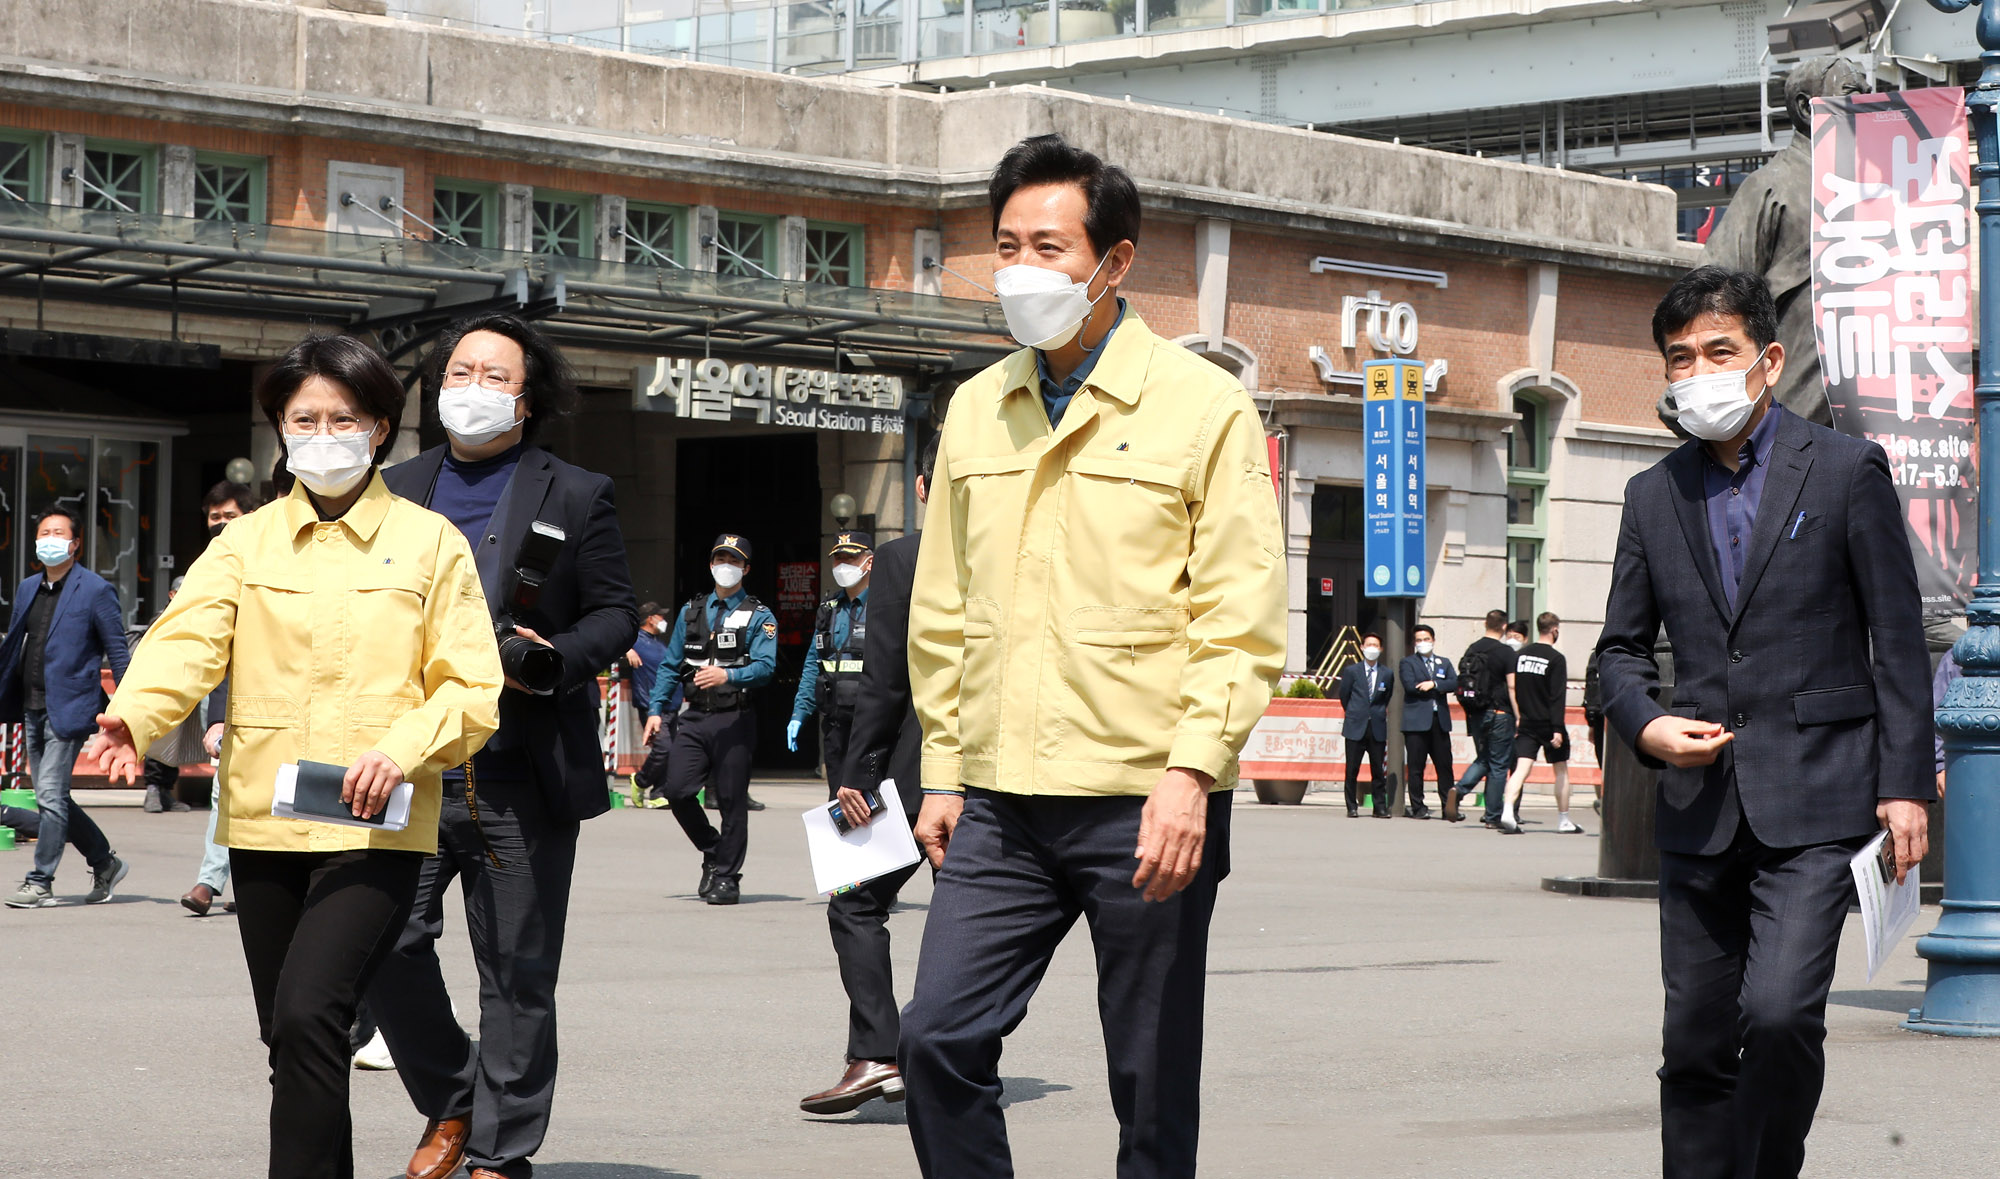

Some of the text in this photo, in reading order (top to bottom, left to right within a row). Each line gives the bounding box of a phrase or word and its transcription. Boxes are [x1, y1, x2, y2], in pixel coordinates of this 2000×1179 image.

[1820, 172, 1892, 386] 사이트
[1891, 135, 1968, 420] 보더리스
[1341, 290, 1418, 354] rto
[647, 357, 771, 424] 서울역
[776, 405, 816, 427] Seoul
[817, 408, 866, 432] Station
[1377, 406, 1385, 429] 1
[1410, 406, 1416, 429] 1
[1376, 454, 1387, 509] 서울역
[1408, 454, 1418, 510] 서울역
